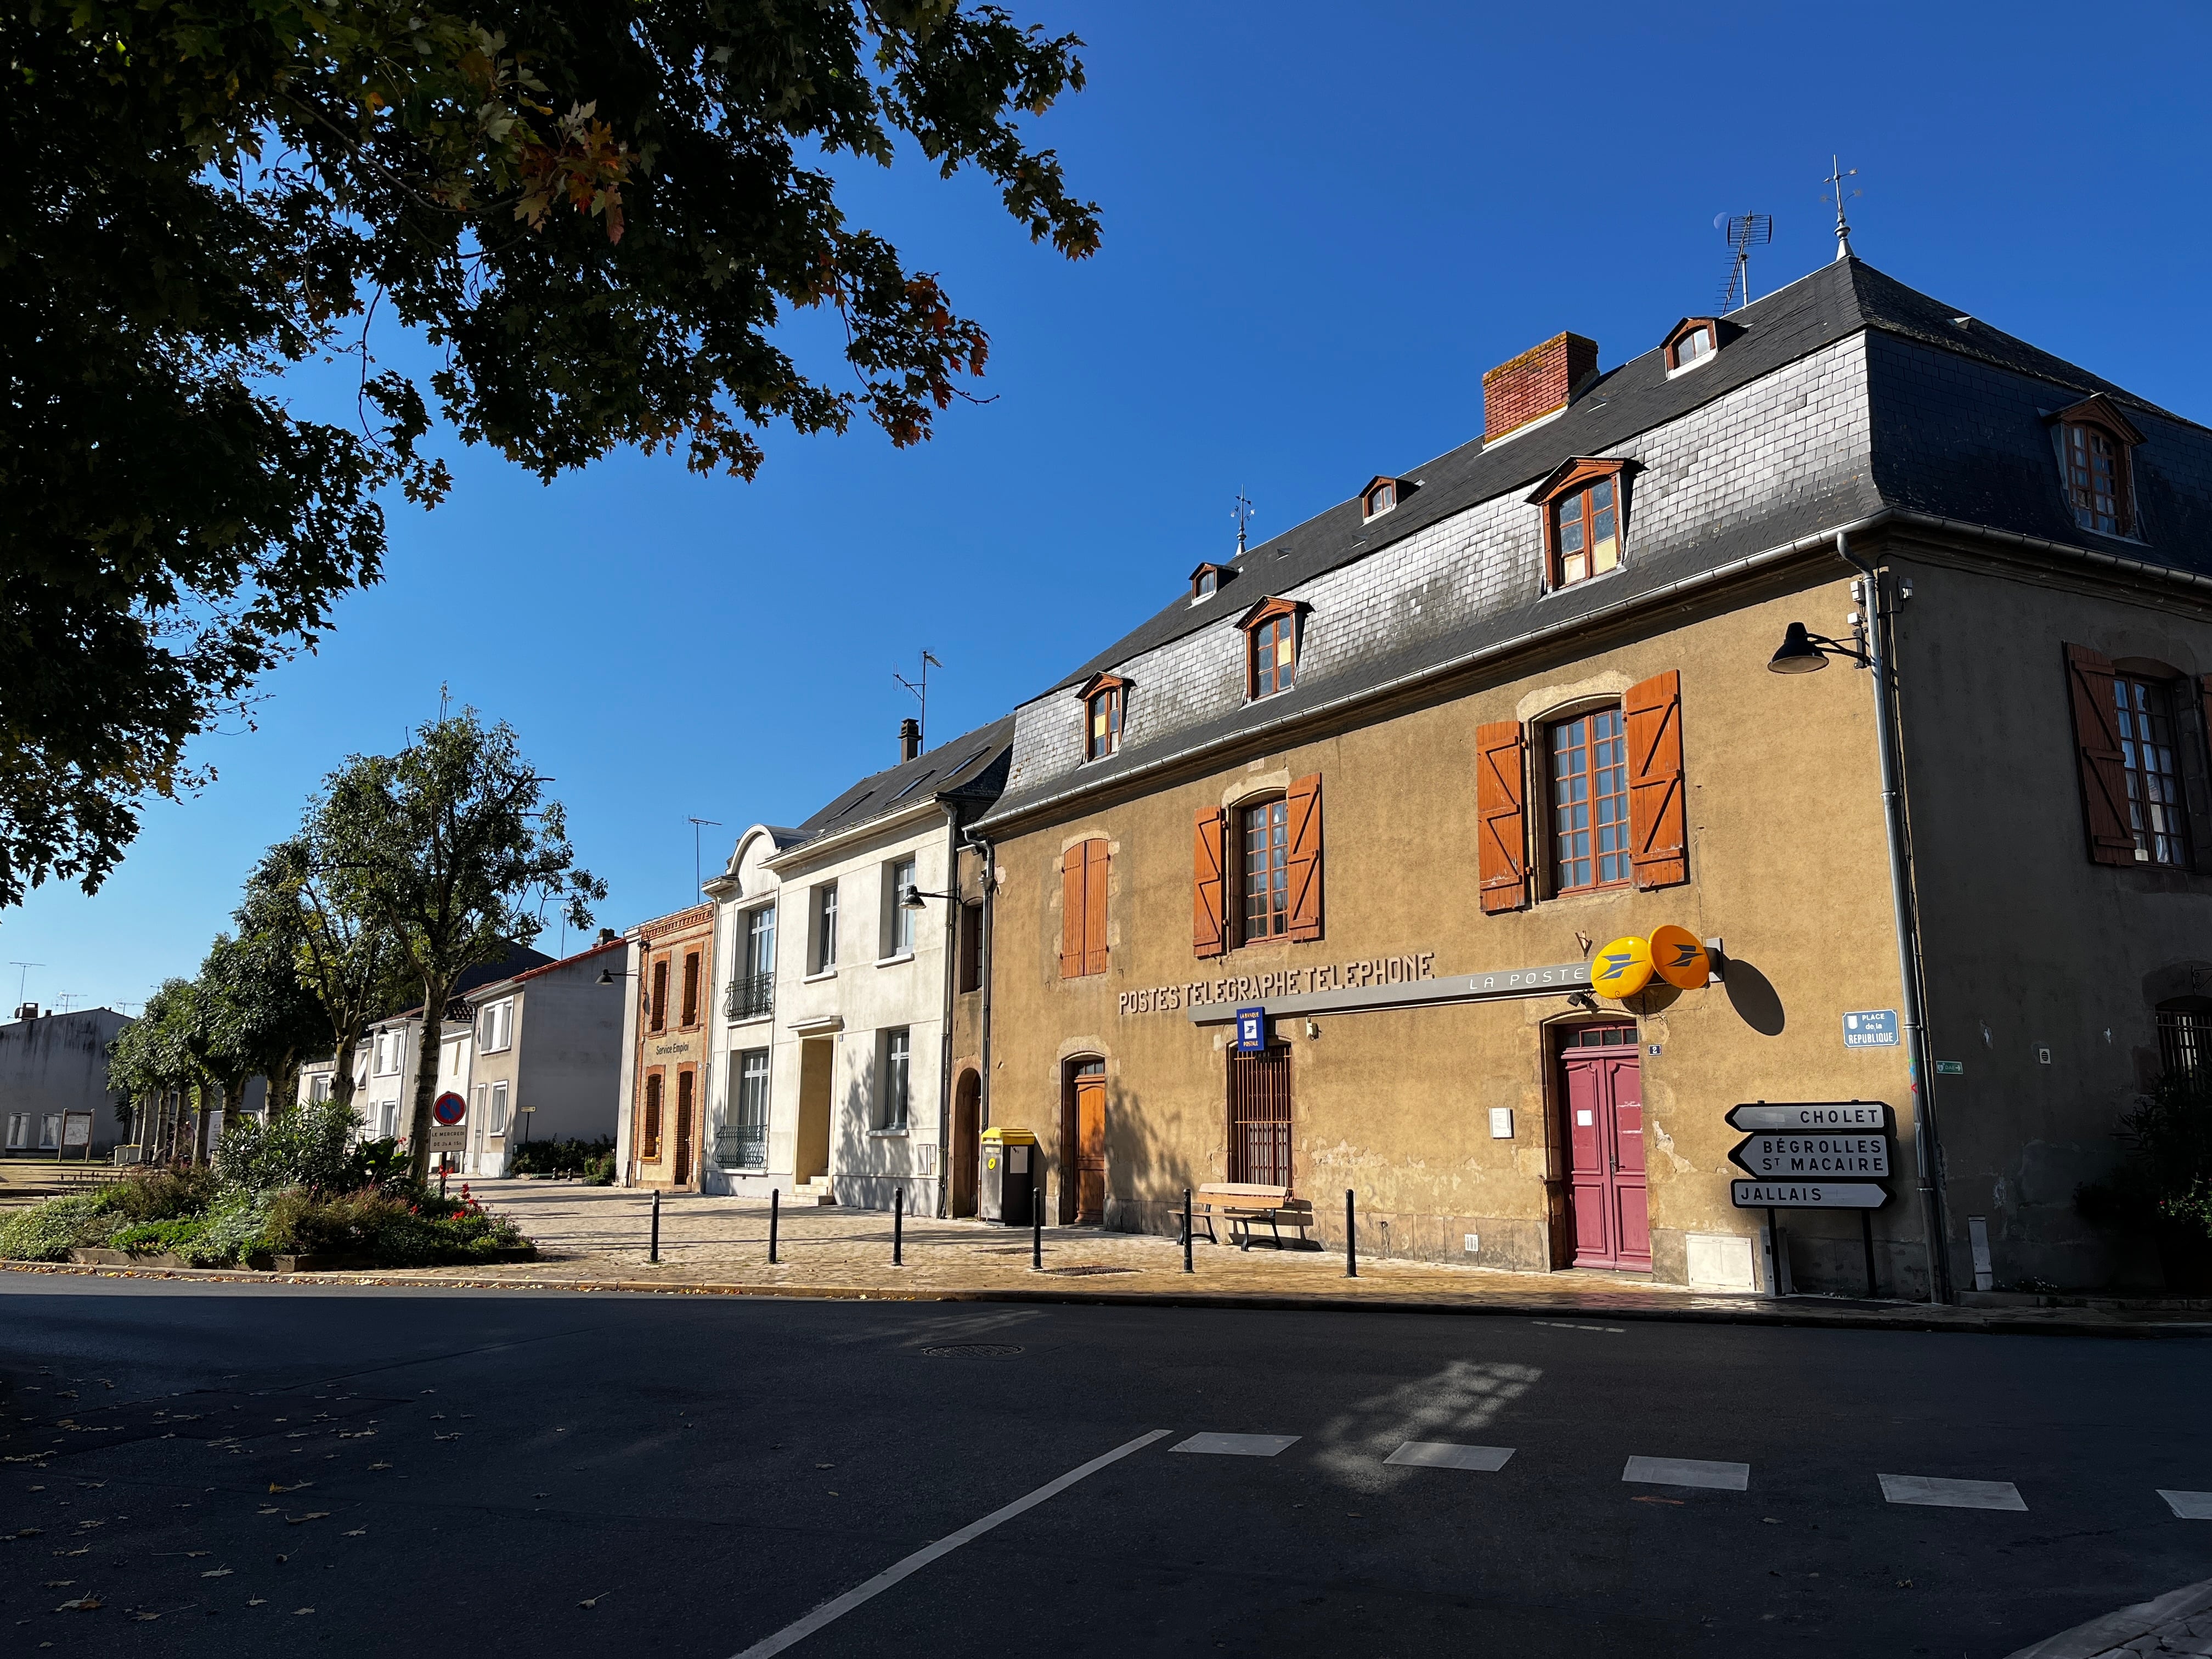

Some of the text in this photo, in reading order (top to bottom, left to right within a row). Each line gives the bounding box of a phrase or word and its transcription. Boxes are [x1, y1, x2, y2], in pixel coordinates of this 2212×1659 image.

[1119, 952, 1435, 1015] POSTES TELEGRAPHE TELEPHONE
[1470, 967, 1585, 990] LA POSTE
[1848, 1032, 1893, 1044] REPUBLIQUE
[656, 1041, 689, 1055] Service Emploi
[1800, 1109, 1877, 1123] CHOLET
[1763, 1138, 1882, 1154] BÉGROLLES
[1791, 1158, 1883, 1171] MACAIRE
[1741, 1187, 1821, 1200] JALLAIS
